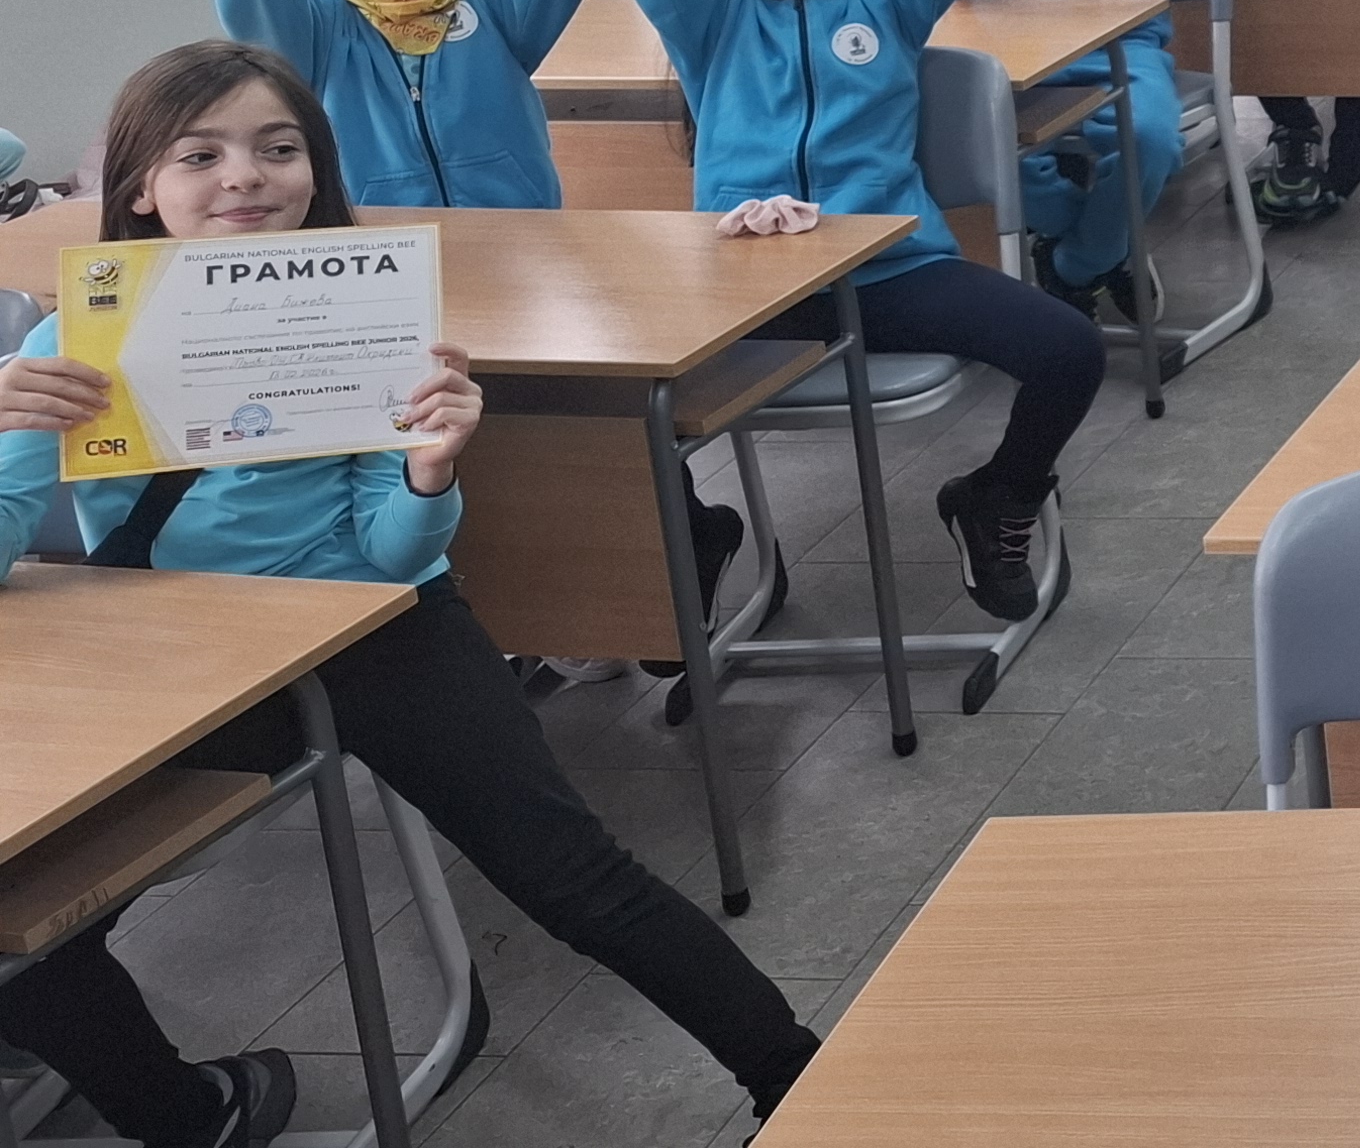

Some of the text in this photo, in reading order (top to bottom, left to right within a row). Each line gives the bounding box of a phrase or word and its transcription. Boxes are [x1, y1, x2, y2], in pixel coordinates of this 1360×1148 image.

[185, 240, 416, 262] BULGARIAN NATIONAL ENGLISH SPELLING BEE
[207, 254, 398, 285] ГРАМОТА
[249, 384, 360, 400] CONGRATULATIONS!
